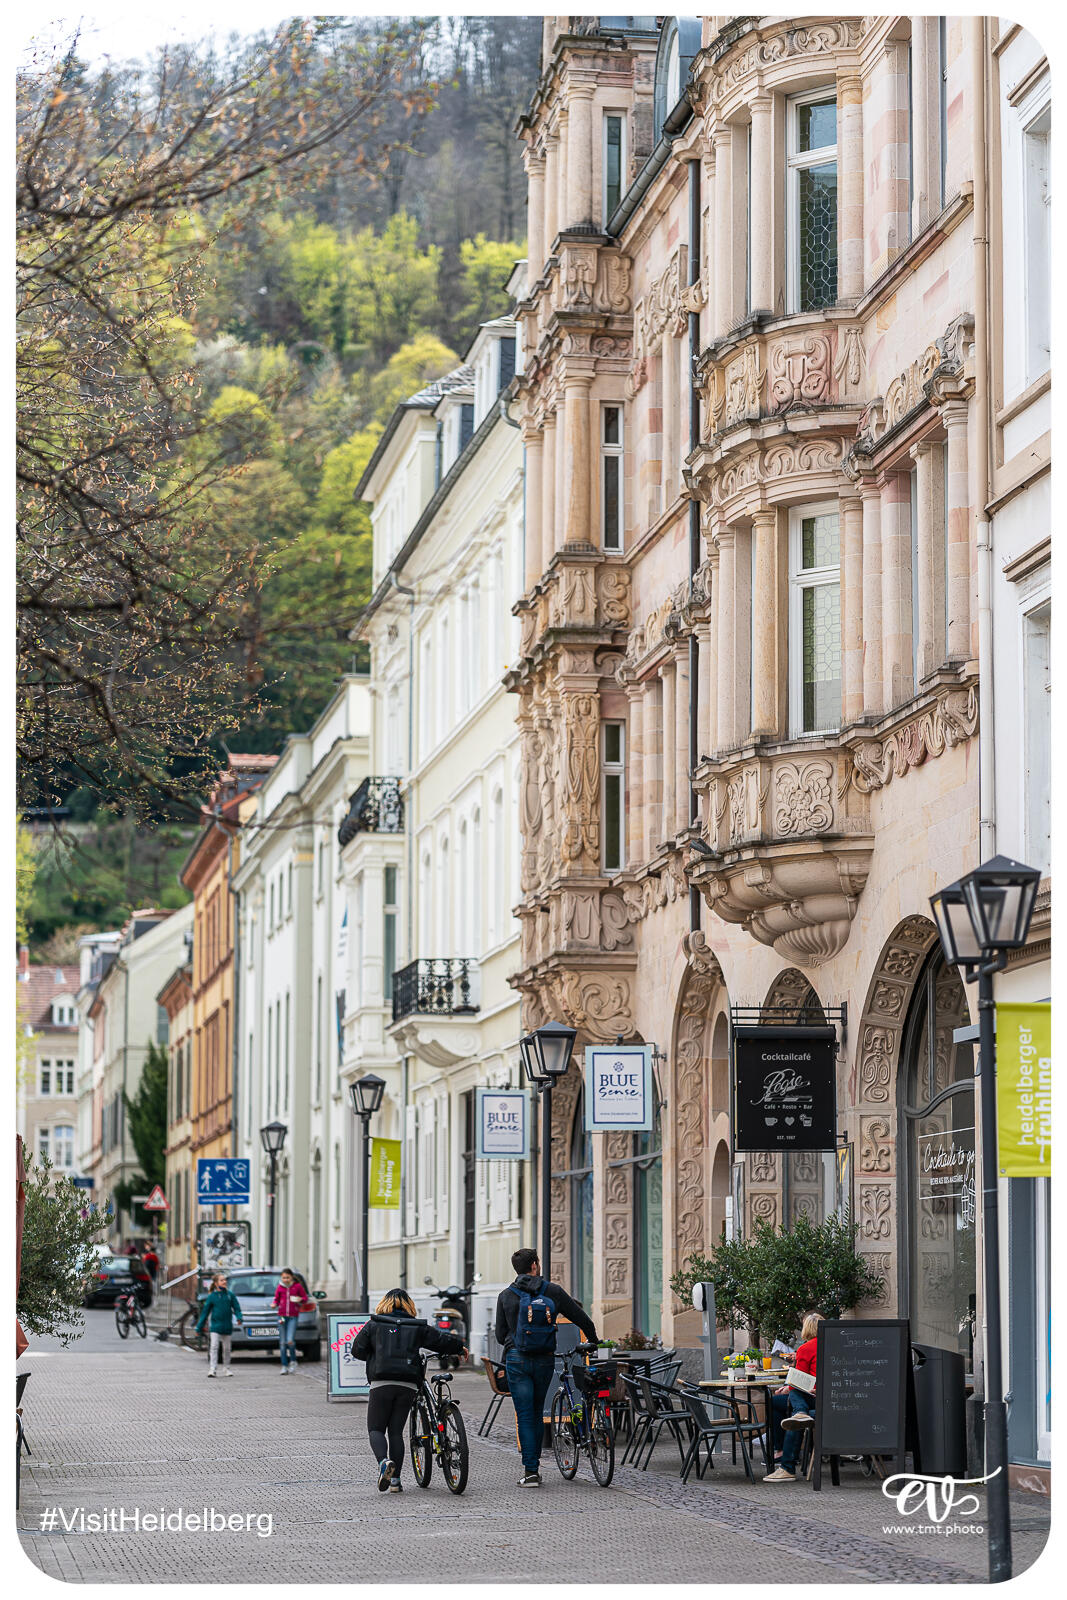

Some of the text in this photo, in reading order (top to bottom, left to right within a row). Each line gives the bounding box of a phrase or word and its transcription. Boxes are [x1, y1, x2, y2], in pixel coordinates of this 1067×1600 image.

[761, 1053, 812, 1061] Cocktailcafé
[600, 1074, 638, 1087] BLUE
[1016, 1025, 1037, 1146] heidelberger
[599, 1087, 640, 1098] Sense
[1035, 1057, 1051, 1163] frühling
[488, 1112, 519, 1123] BLUE
[487, 1123, 520, 1132] Sense
[924, 1142, 976, 1181] Cocktails to go
